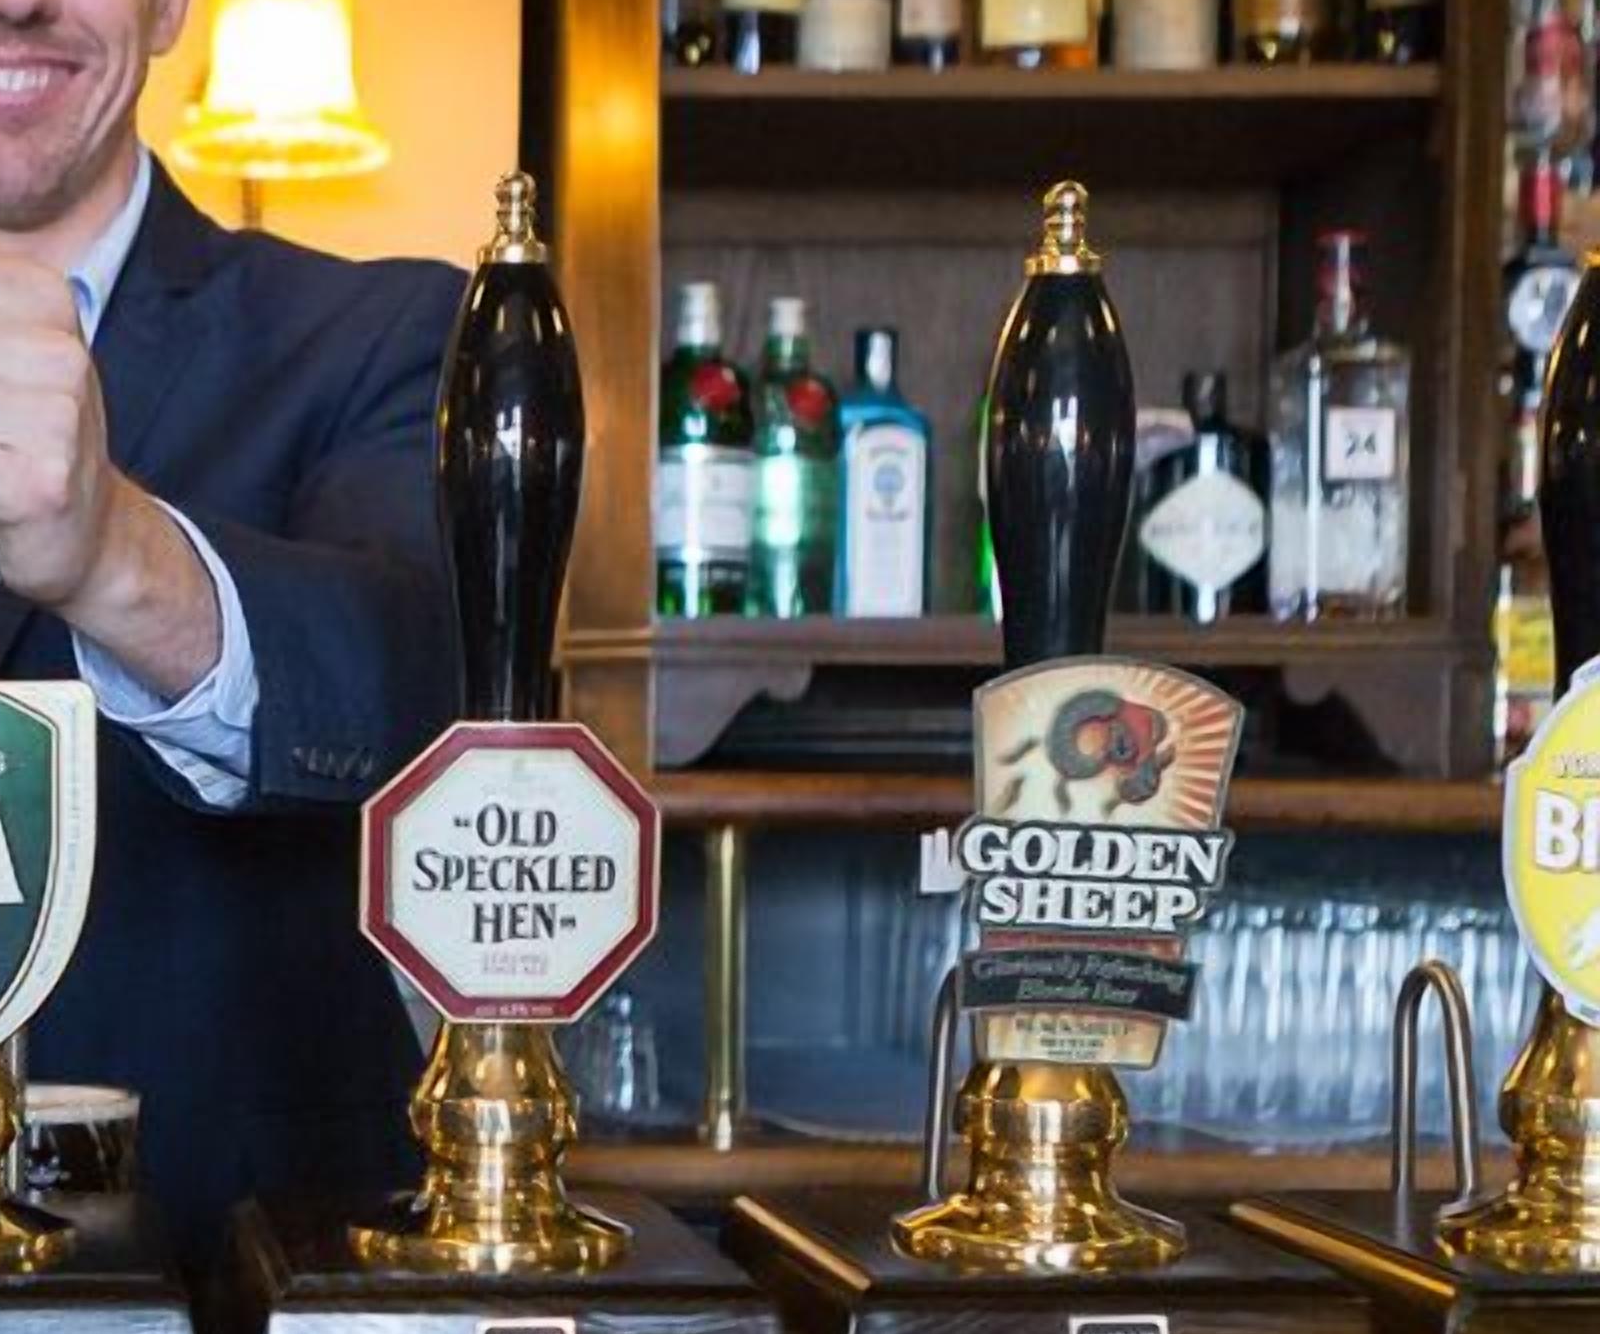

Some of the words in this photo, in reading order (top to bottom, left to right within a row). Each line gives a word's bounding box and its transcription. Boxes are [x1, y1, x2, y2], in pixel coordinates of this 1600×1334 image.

[1343, 429, 1377, 460] 24
[412, 847, 617, 893] SPECKLED
[962, 823, 1225, 884] GOLDEN
[979, 876, 1198, 932] SHEEP
